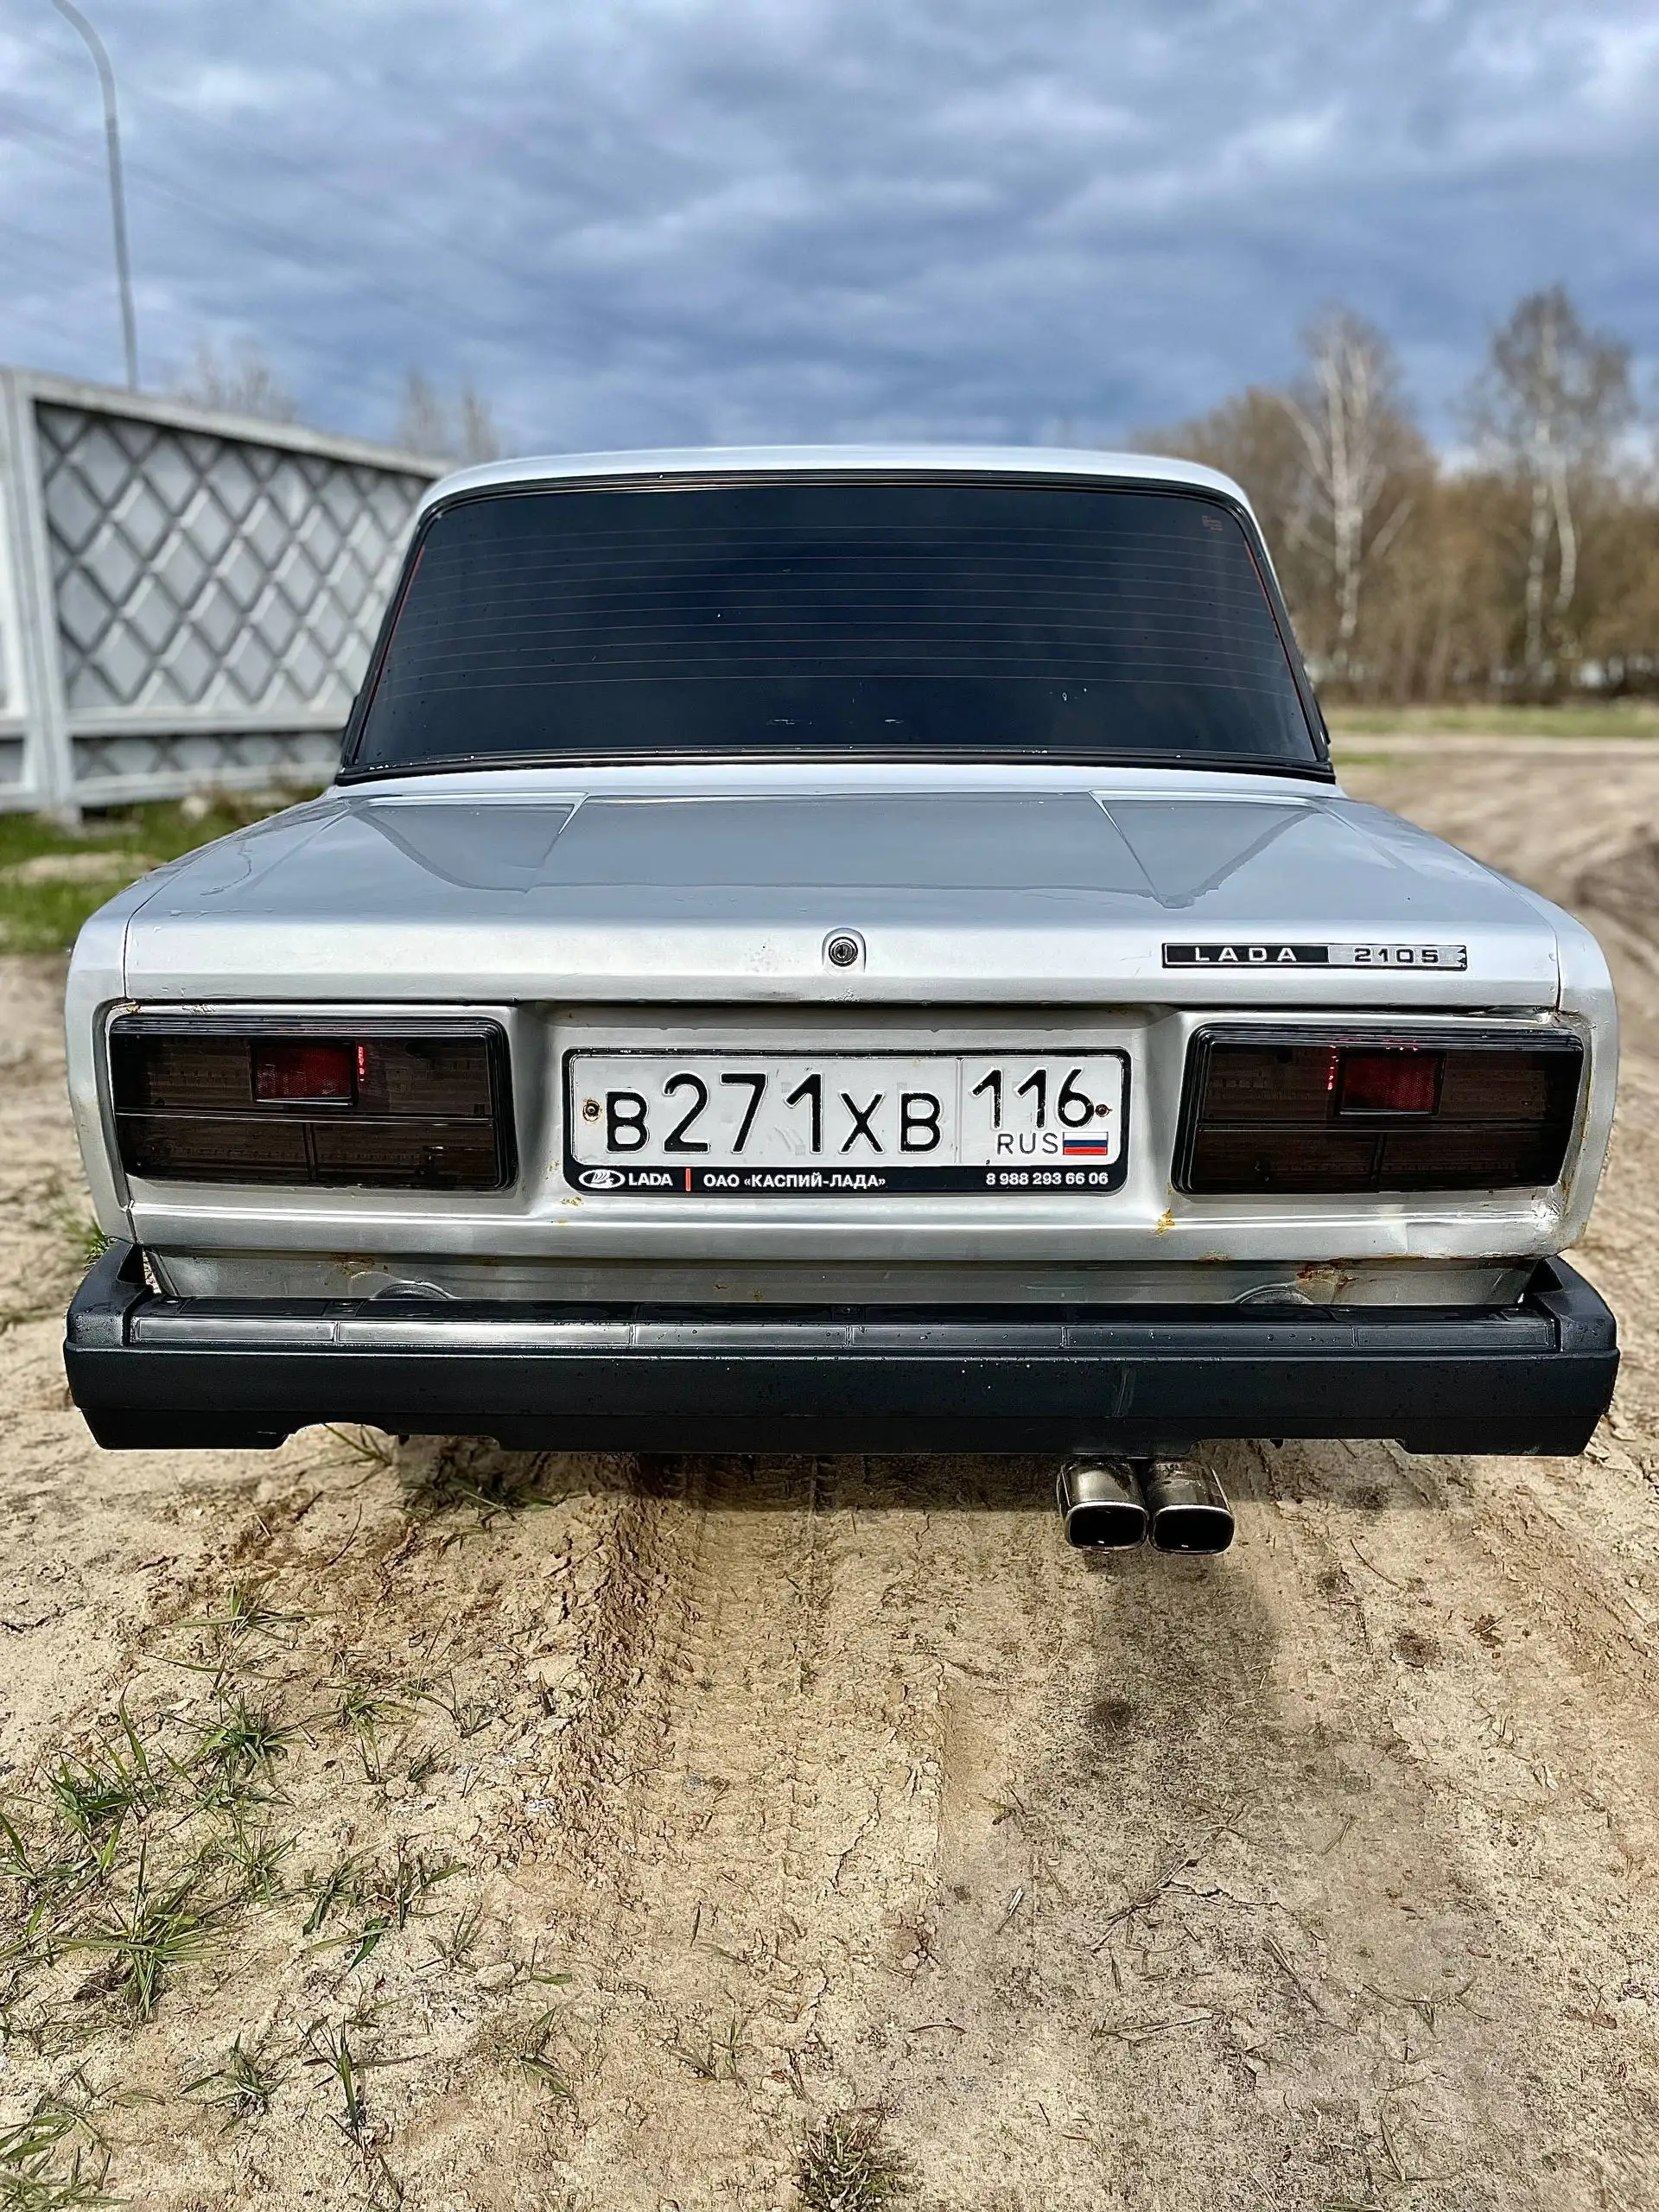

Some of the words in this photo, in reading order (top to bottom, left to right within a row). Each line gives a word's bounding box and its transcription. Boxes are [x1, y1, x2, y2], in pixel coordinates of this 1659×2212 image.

[1194, 947, 1297, 962] LADA
[1353, 948, 1440, 963] 2105
[969, 1069, 1095, 1128] 116
[996, 1133, 1058, 1154] RUS
[628, 1173, 673, 1186] LADA
[703, 1173, 740, 1187] ОАО
[744, 1172, 886, 1189] «КАСПИЙ-ЛАДА»
[986, 1173, 995, 1185] 8
[999, 1173, 1029, 1185] 988
[1032, 1173, 1062, 1185] 293
[1065, 1173, 1085, 1185] 66
[1089, 1173, 1109, 1185] 06
